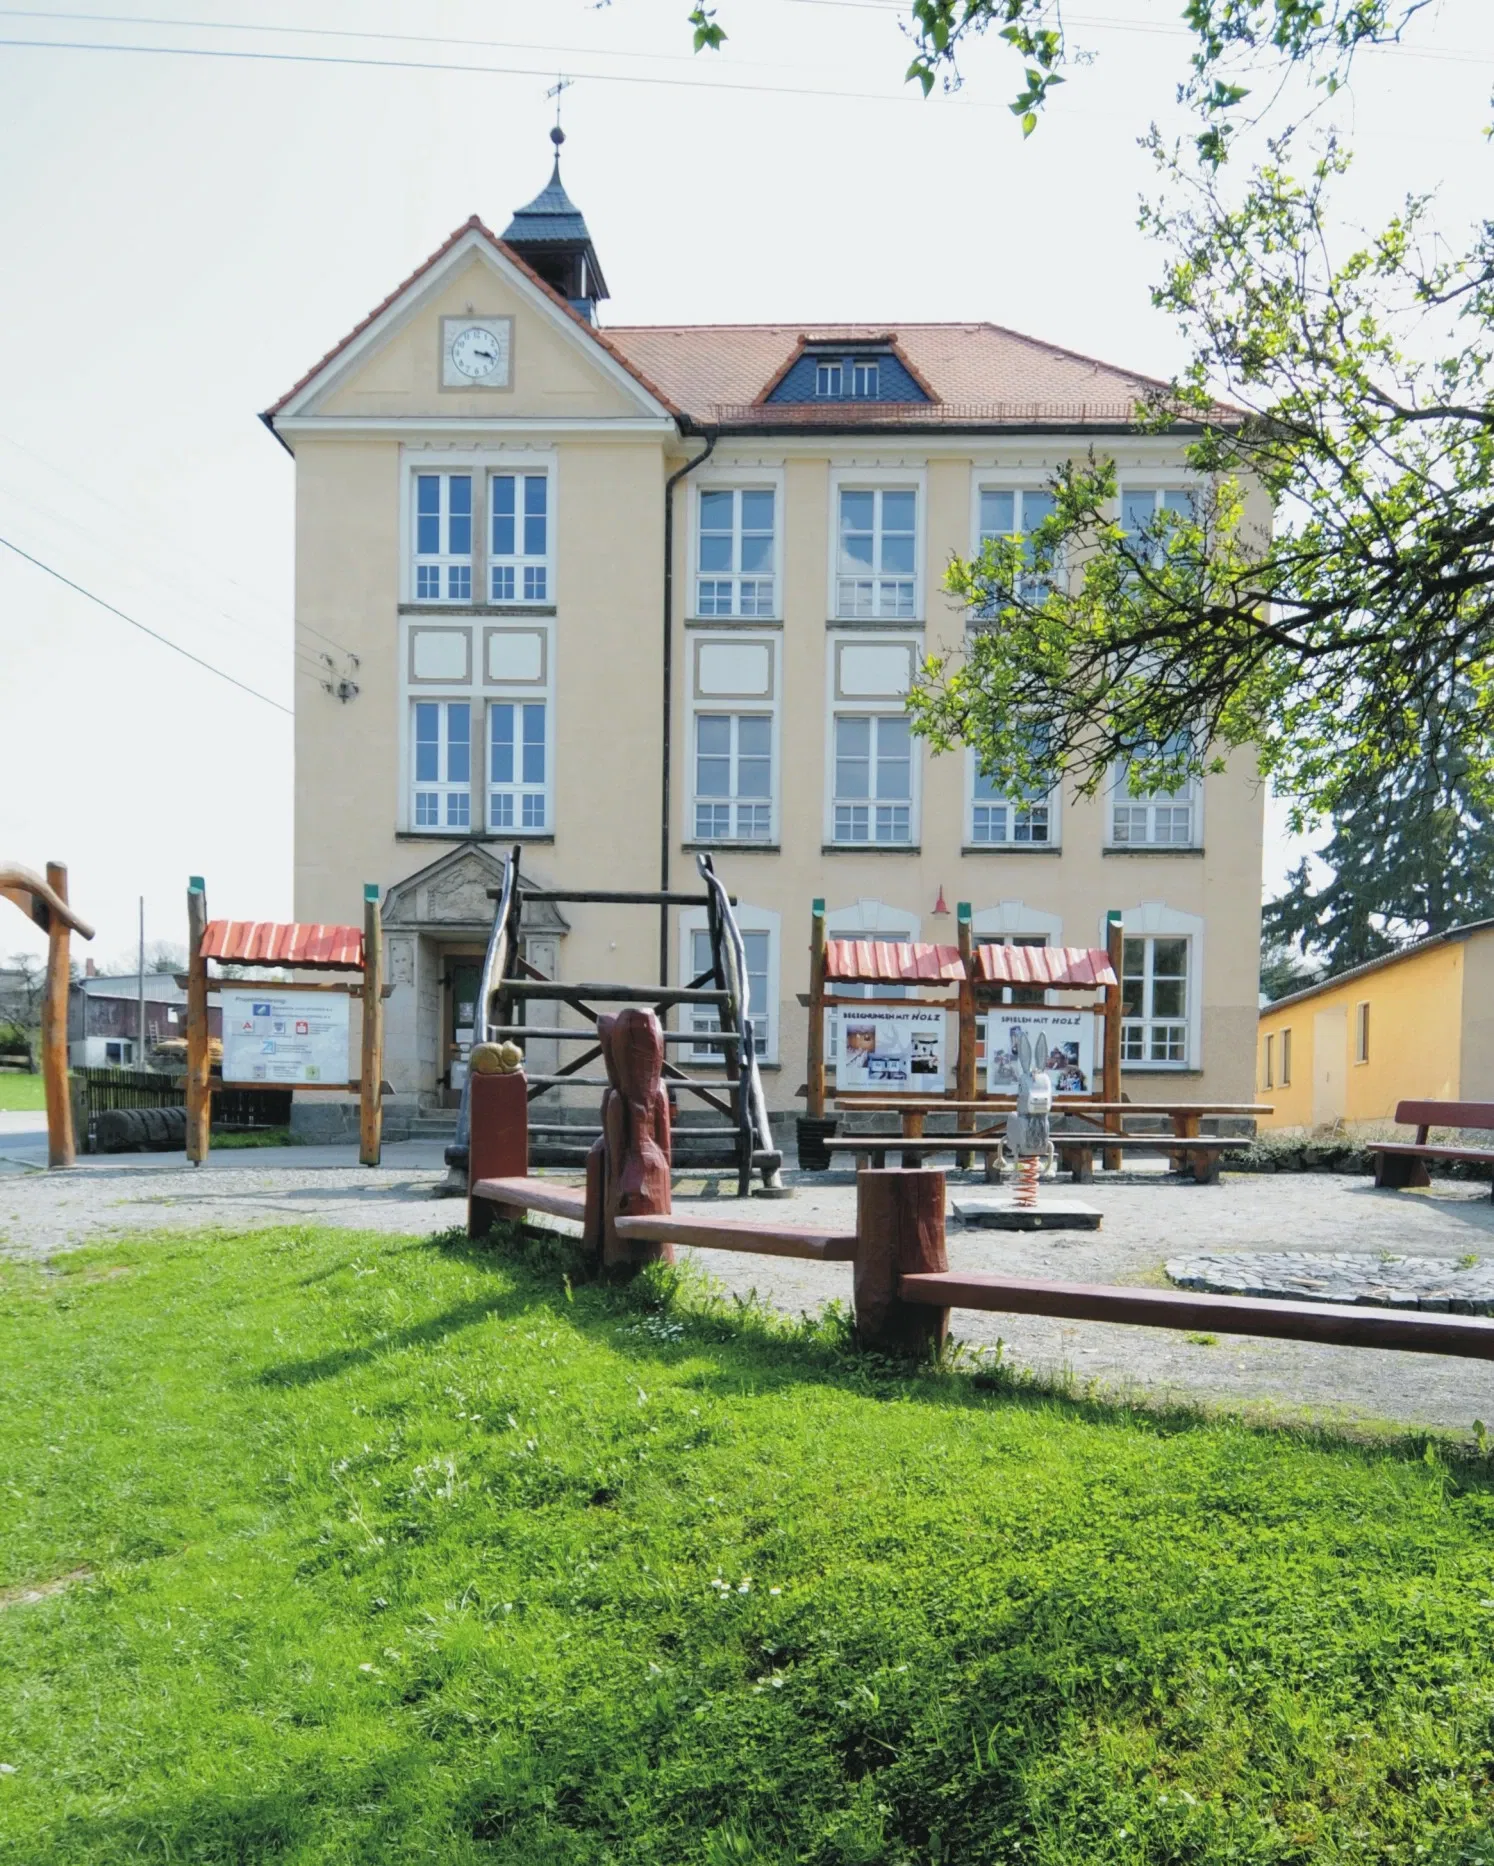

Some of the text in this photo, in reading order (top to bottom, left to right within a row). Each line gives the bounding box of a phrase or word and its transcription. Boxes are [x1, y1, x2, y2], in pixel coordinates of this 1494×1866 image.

[911, 1012, 941, 1021] HOLZ
[1001, 1015, 1032, 1023] SPIELEN
[1051, 1016, 1081, 1025] HOLZ
